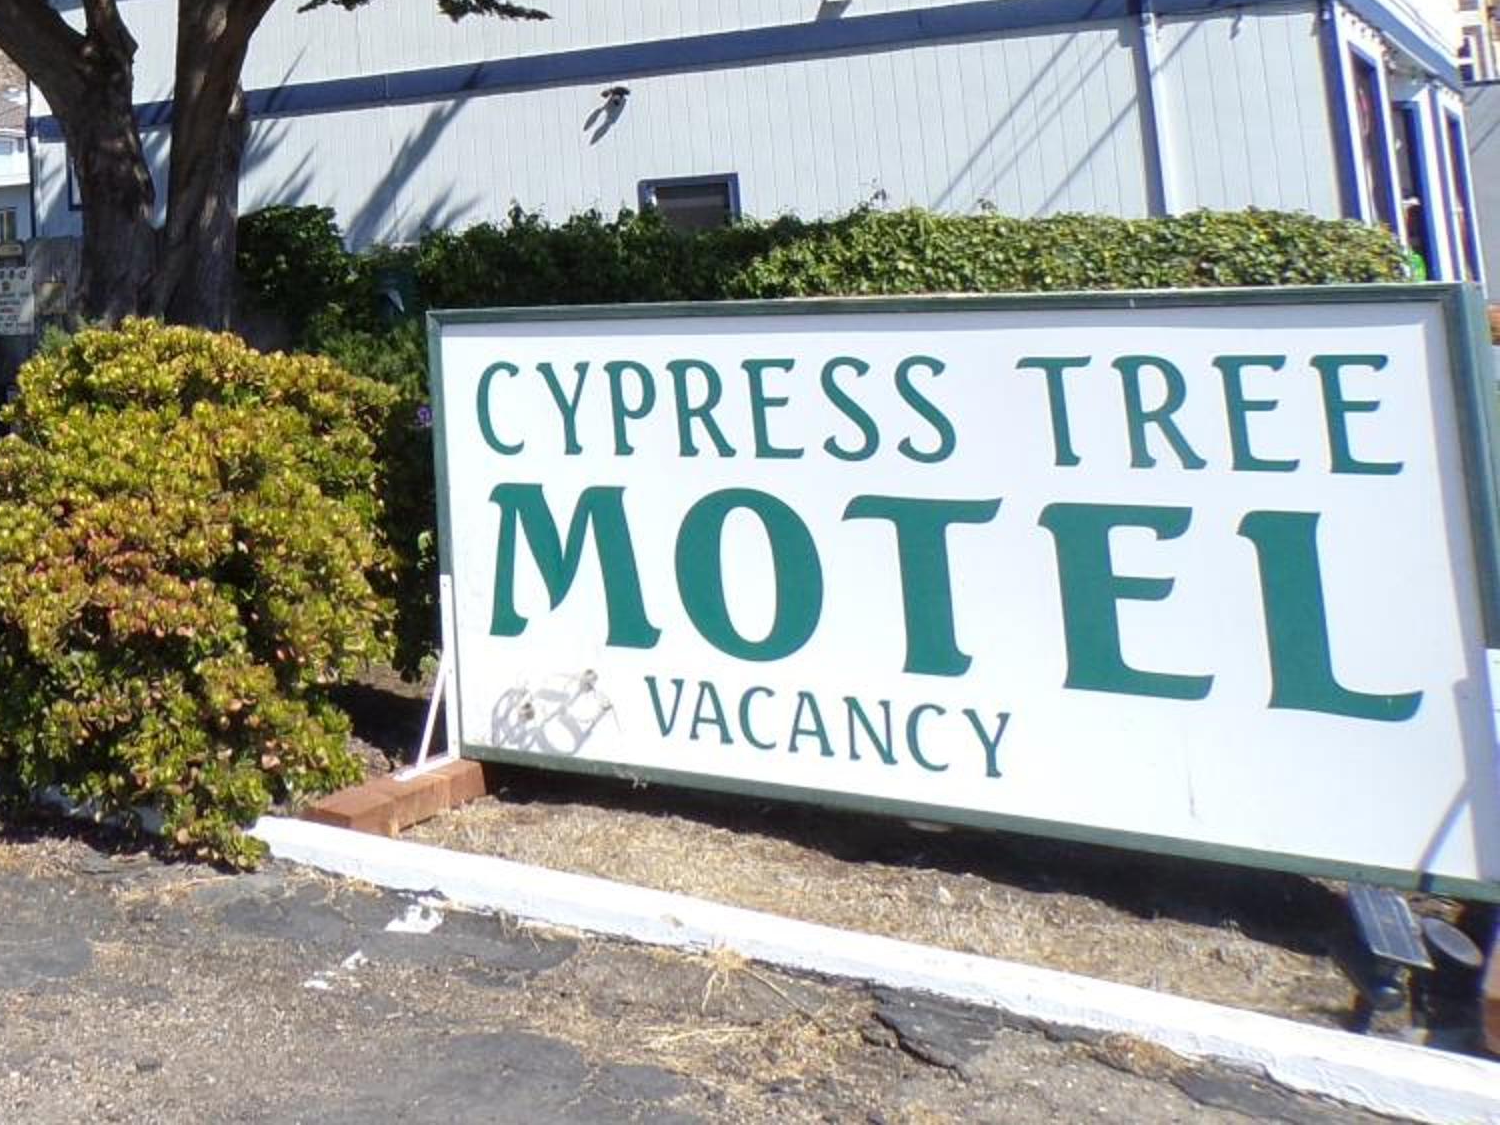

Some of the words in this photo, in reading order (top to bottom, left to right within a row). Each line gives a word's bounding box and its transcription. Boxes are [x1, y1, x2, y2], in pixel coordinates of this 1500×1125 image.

[475, 355, 958, 464] CYPRESS
[1015, 354, 1404, 476] TREE
[488, 482, 1424, 723] MOTEL
[643, 674, 1012, 780] VACANCY
